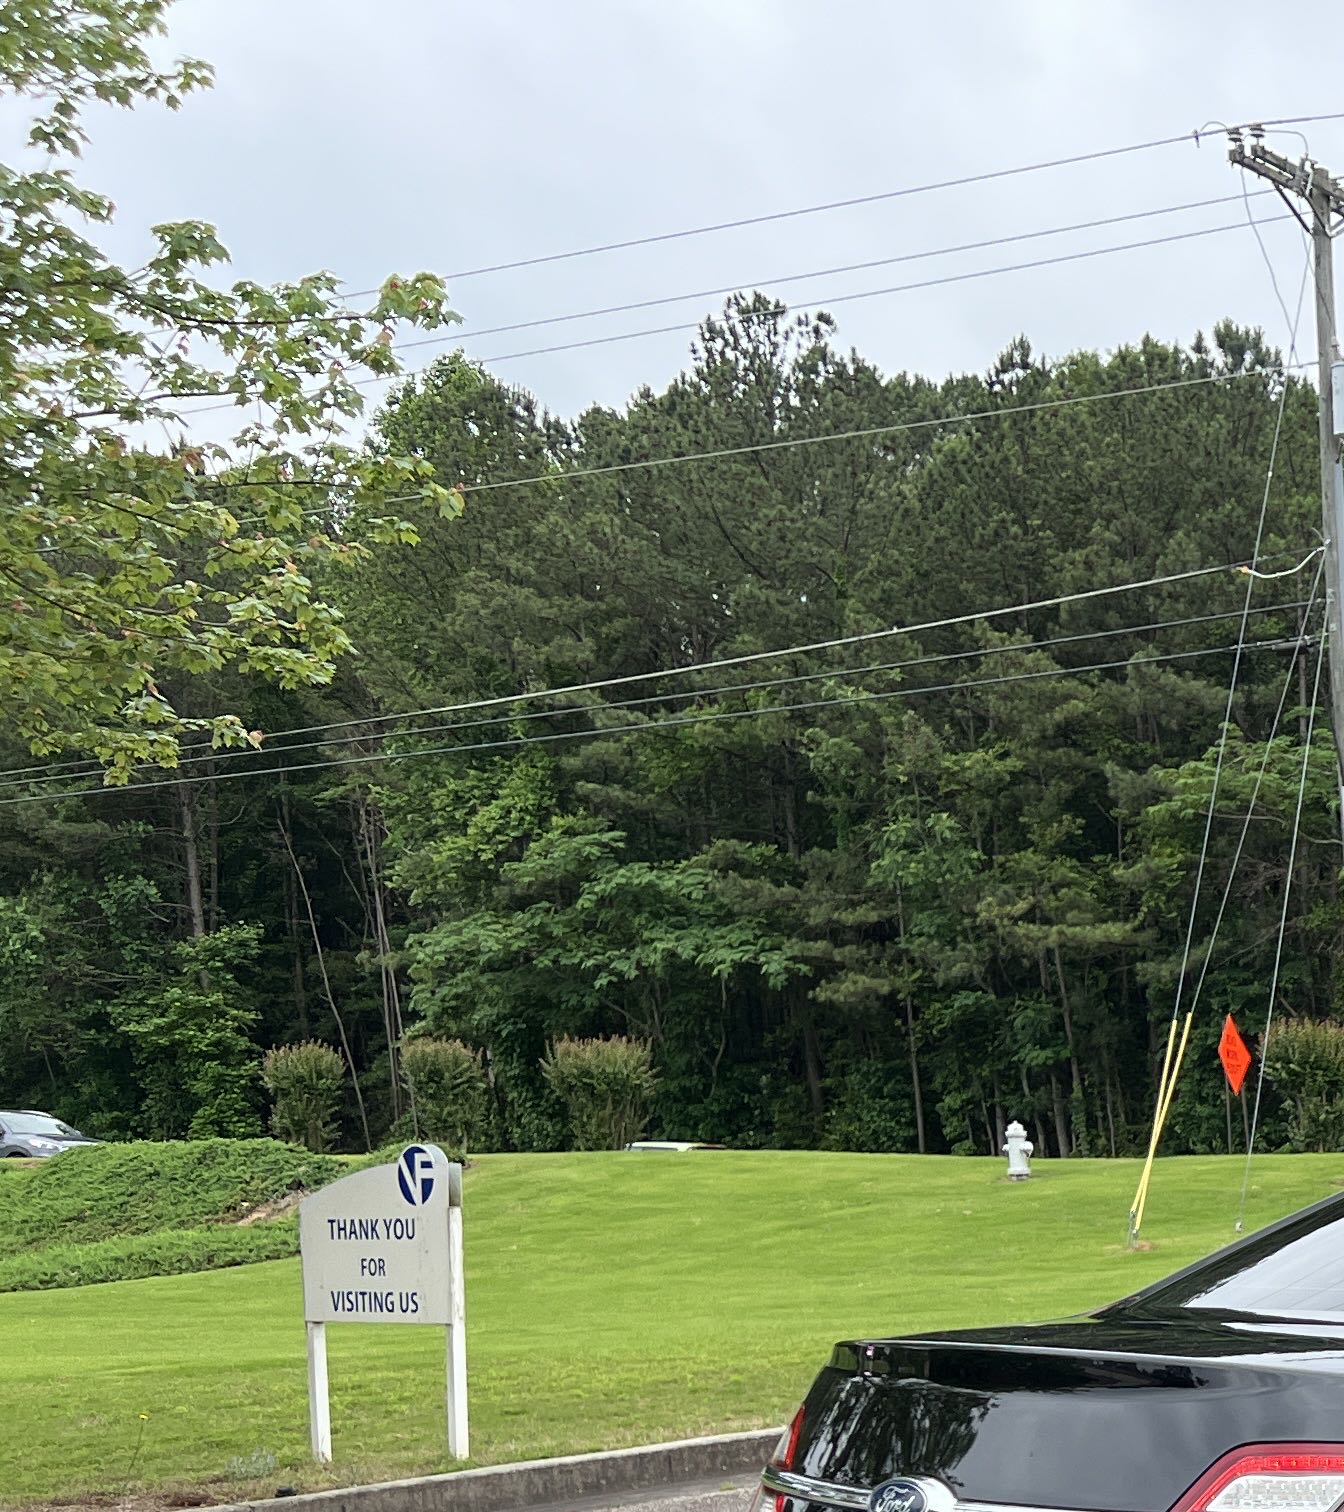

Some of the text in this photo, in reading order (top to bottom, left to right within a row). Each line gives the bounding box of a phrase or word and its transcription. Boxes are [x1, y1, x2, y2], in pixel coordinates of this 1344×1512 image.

[327, 1218, 416, 1241] THANK YOU
[360, 1258, 387, 1278] FOR
[330, 1290, 420, 1314] VISITING US
